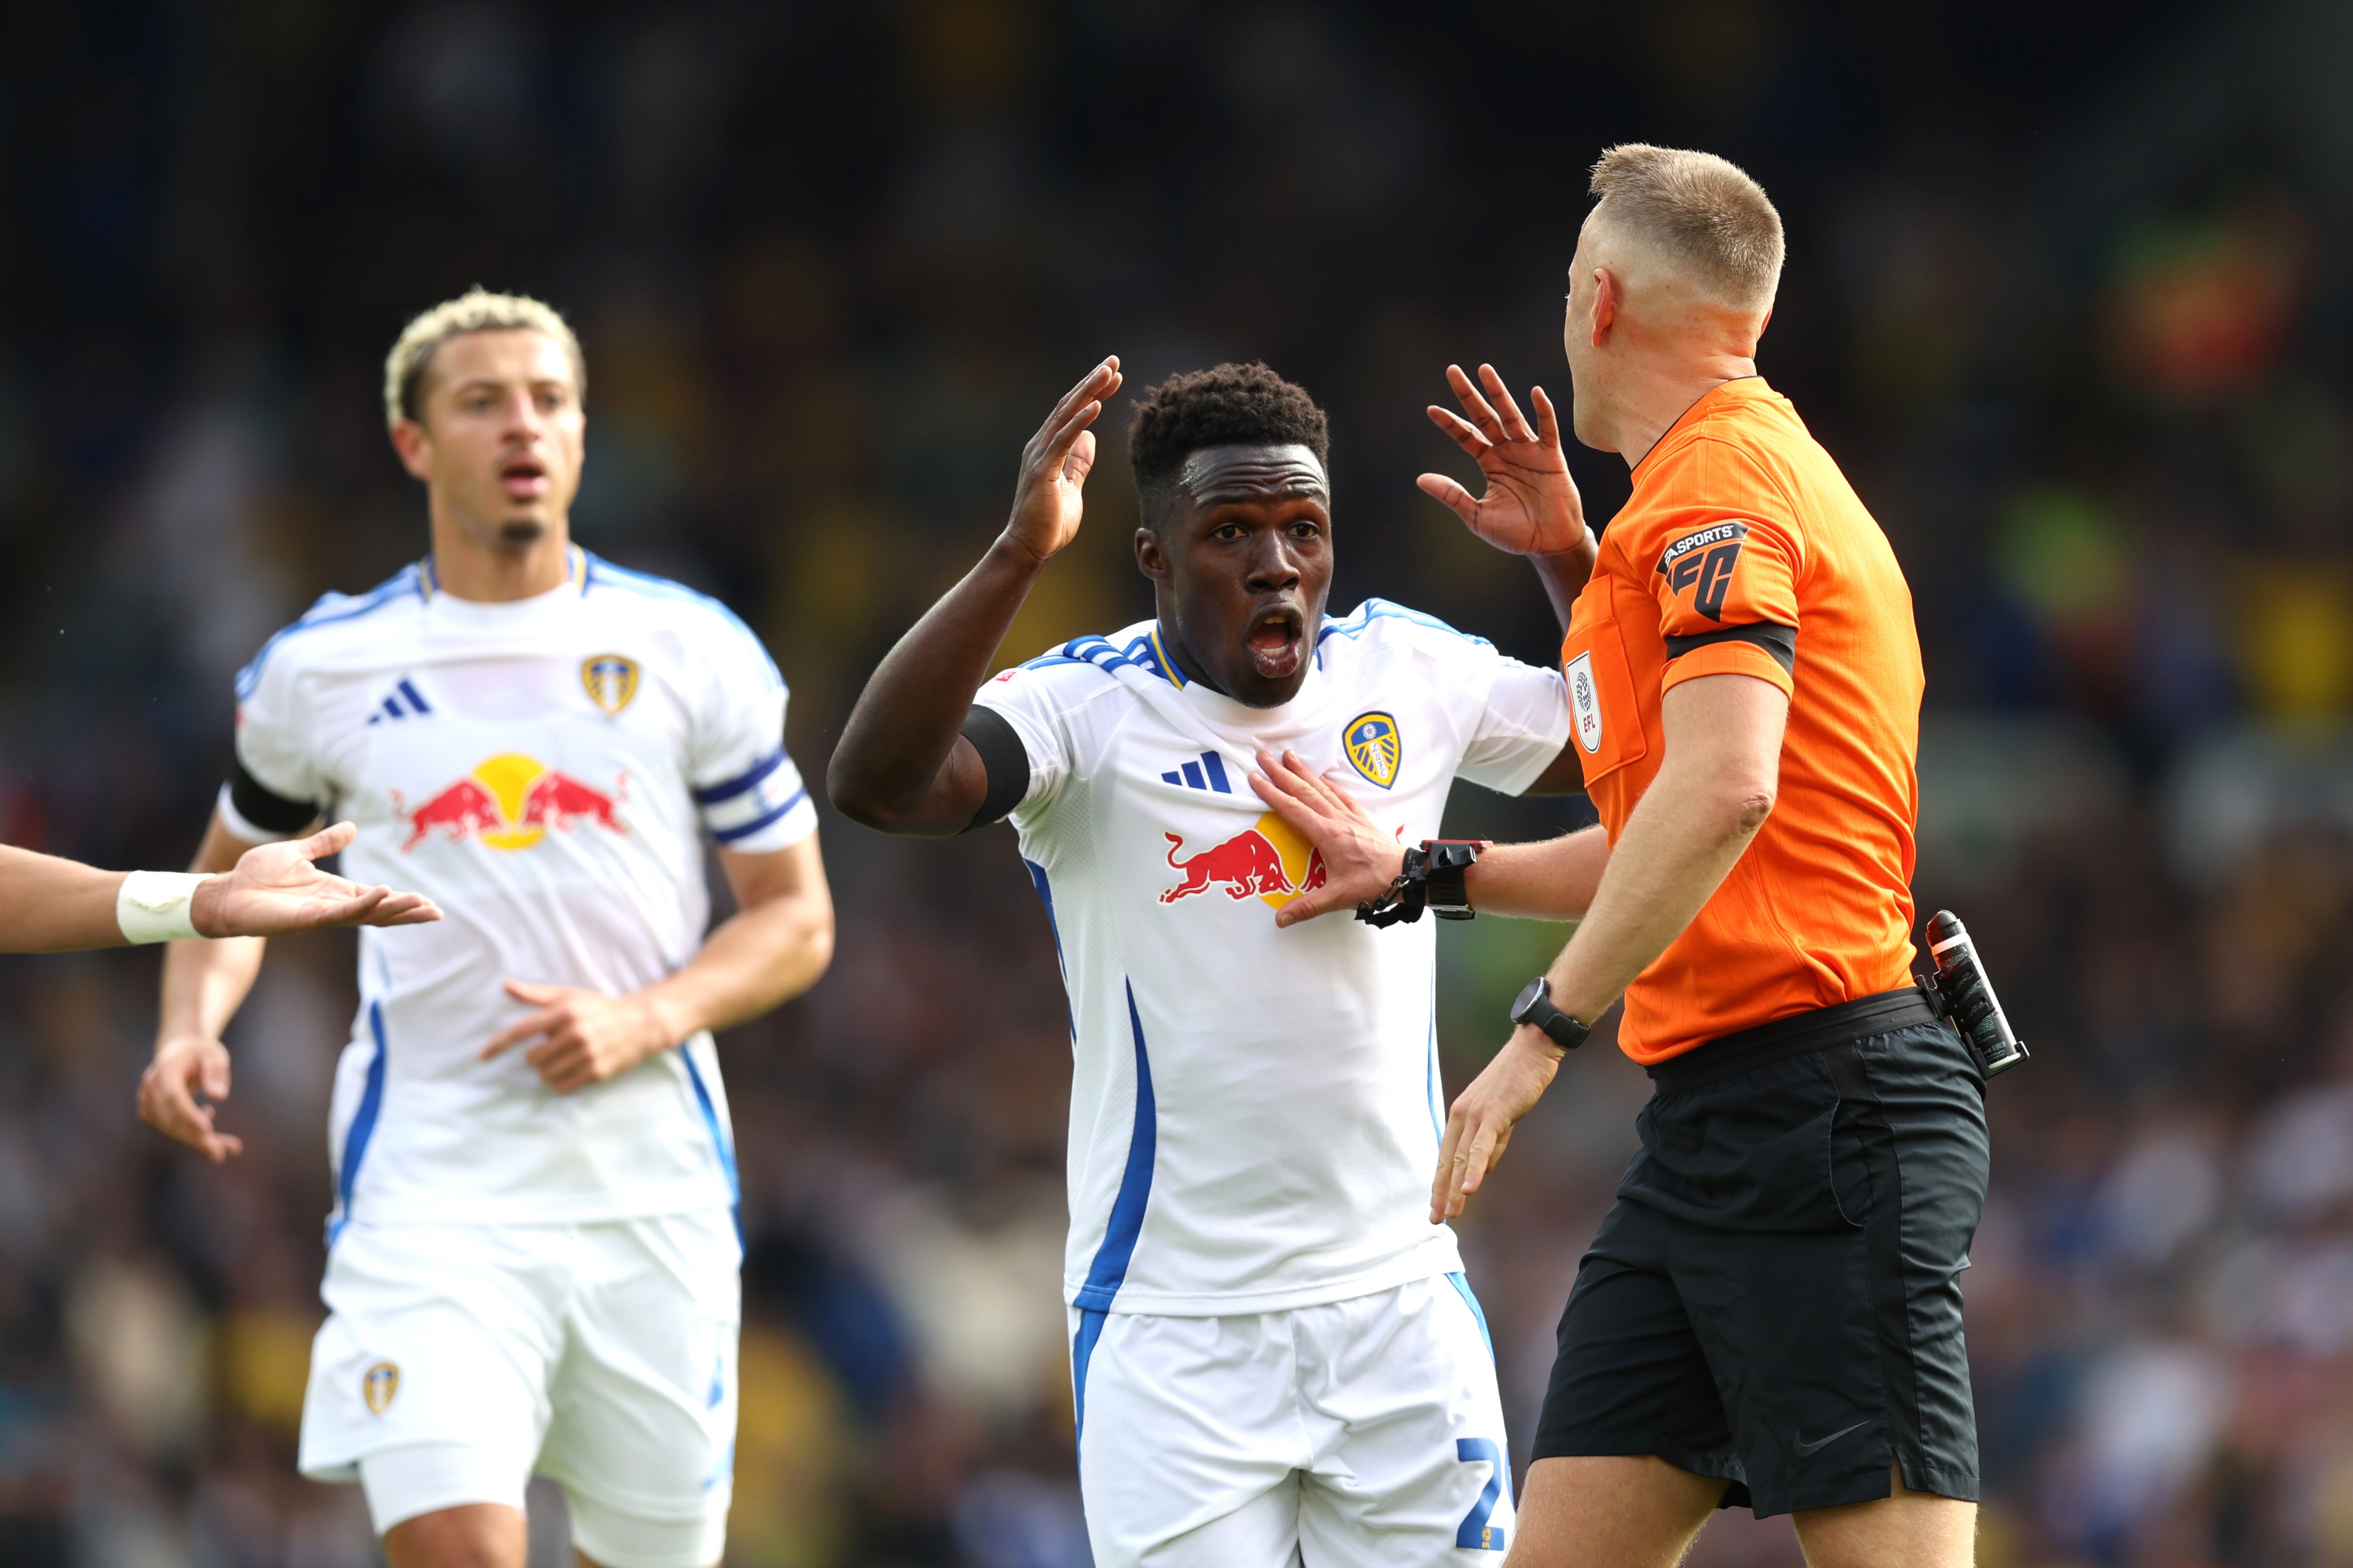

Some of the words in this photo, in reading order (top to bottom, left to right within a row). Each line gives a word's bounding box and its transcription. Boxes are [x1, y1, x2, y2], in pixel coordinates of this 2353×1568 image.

[1677, 526, 1732, 554] SPORTS
[1665, 542, 1742, 623] FC
[1583, 713, 1596, 733] EFL
[1456, 1437, 1504, 1551] 2
